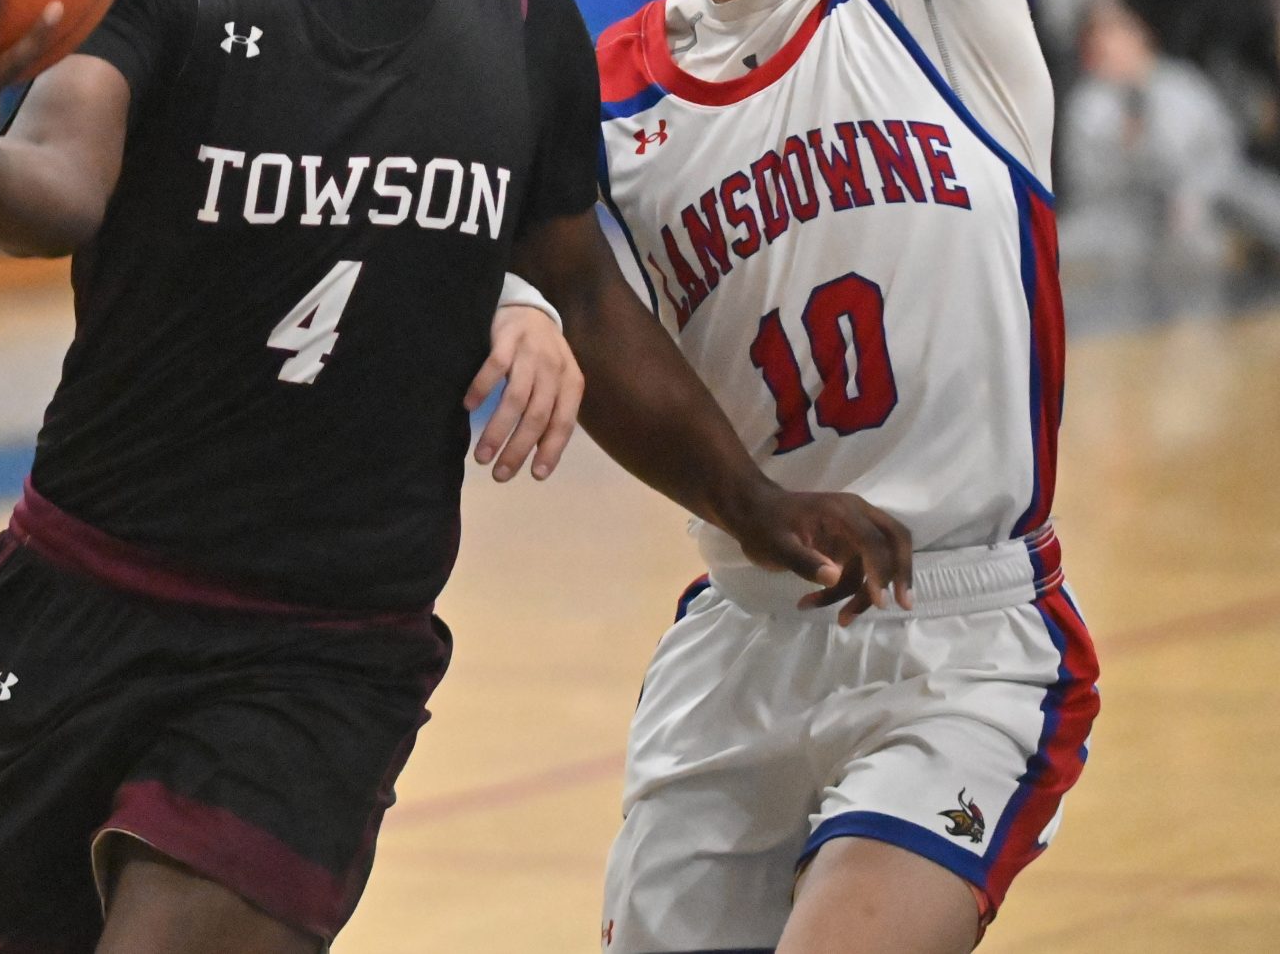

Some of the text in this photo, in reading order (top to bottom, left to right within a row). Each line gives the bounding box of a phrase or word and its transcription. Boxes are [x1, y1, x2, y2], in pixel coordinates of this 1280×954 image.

[196, 143, 511, 240] TOWSON
[266, 259, 363, 385] 4
[749, 270, 899, 456] 10
